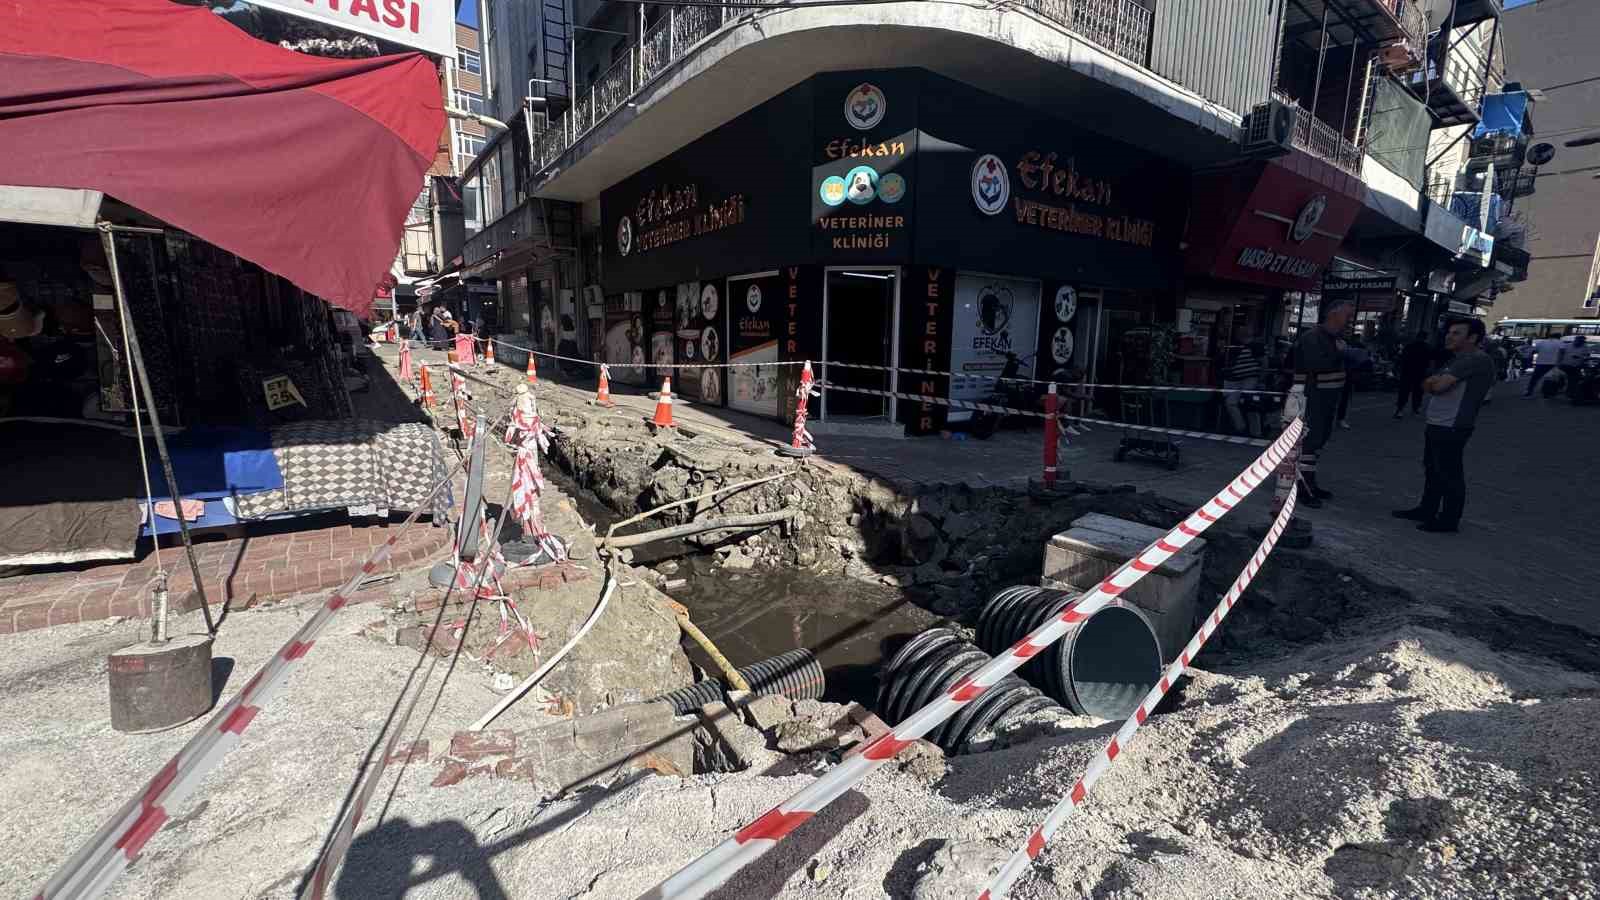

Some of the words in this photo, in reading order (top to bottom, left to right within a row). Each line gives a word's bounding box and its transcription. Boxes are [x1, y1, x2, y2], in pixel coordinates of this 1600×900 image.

[825, 137, 905, 158] Efekan
[1016, 151, 1112, 207] Efekan
[820, 213, 905, 230] VETERİNER
[1014, 199, 1102, 238] VETERİNER
[832, 233, 890, 249] KLİNİĞİ
[973, 336, 1013, 352] EFEKAN
